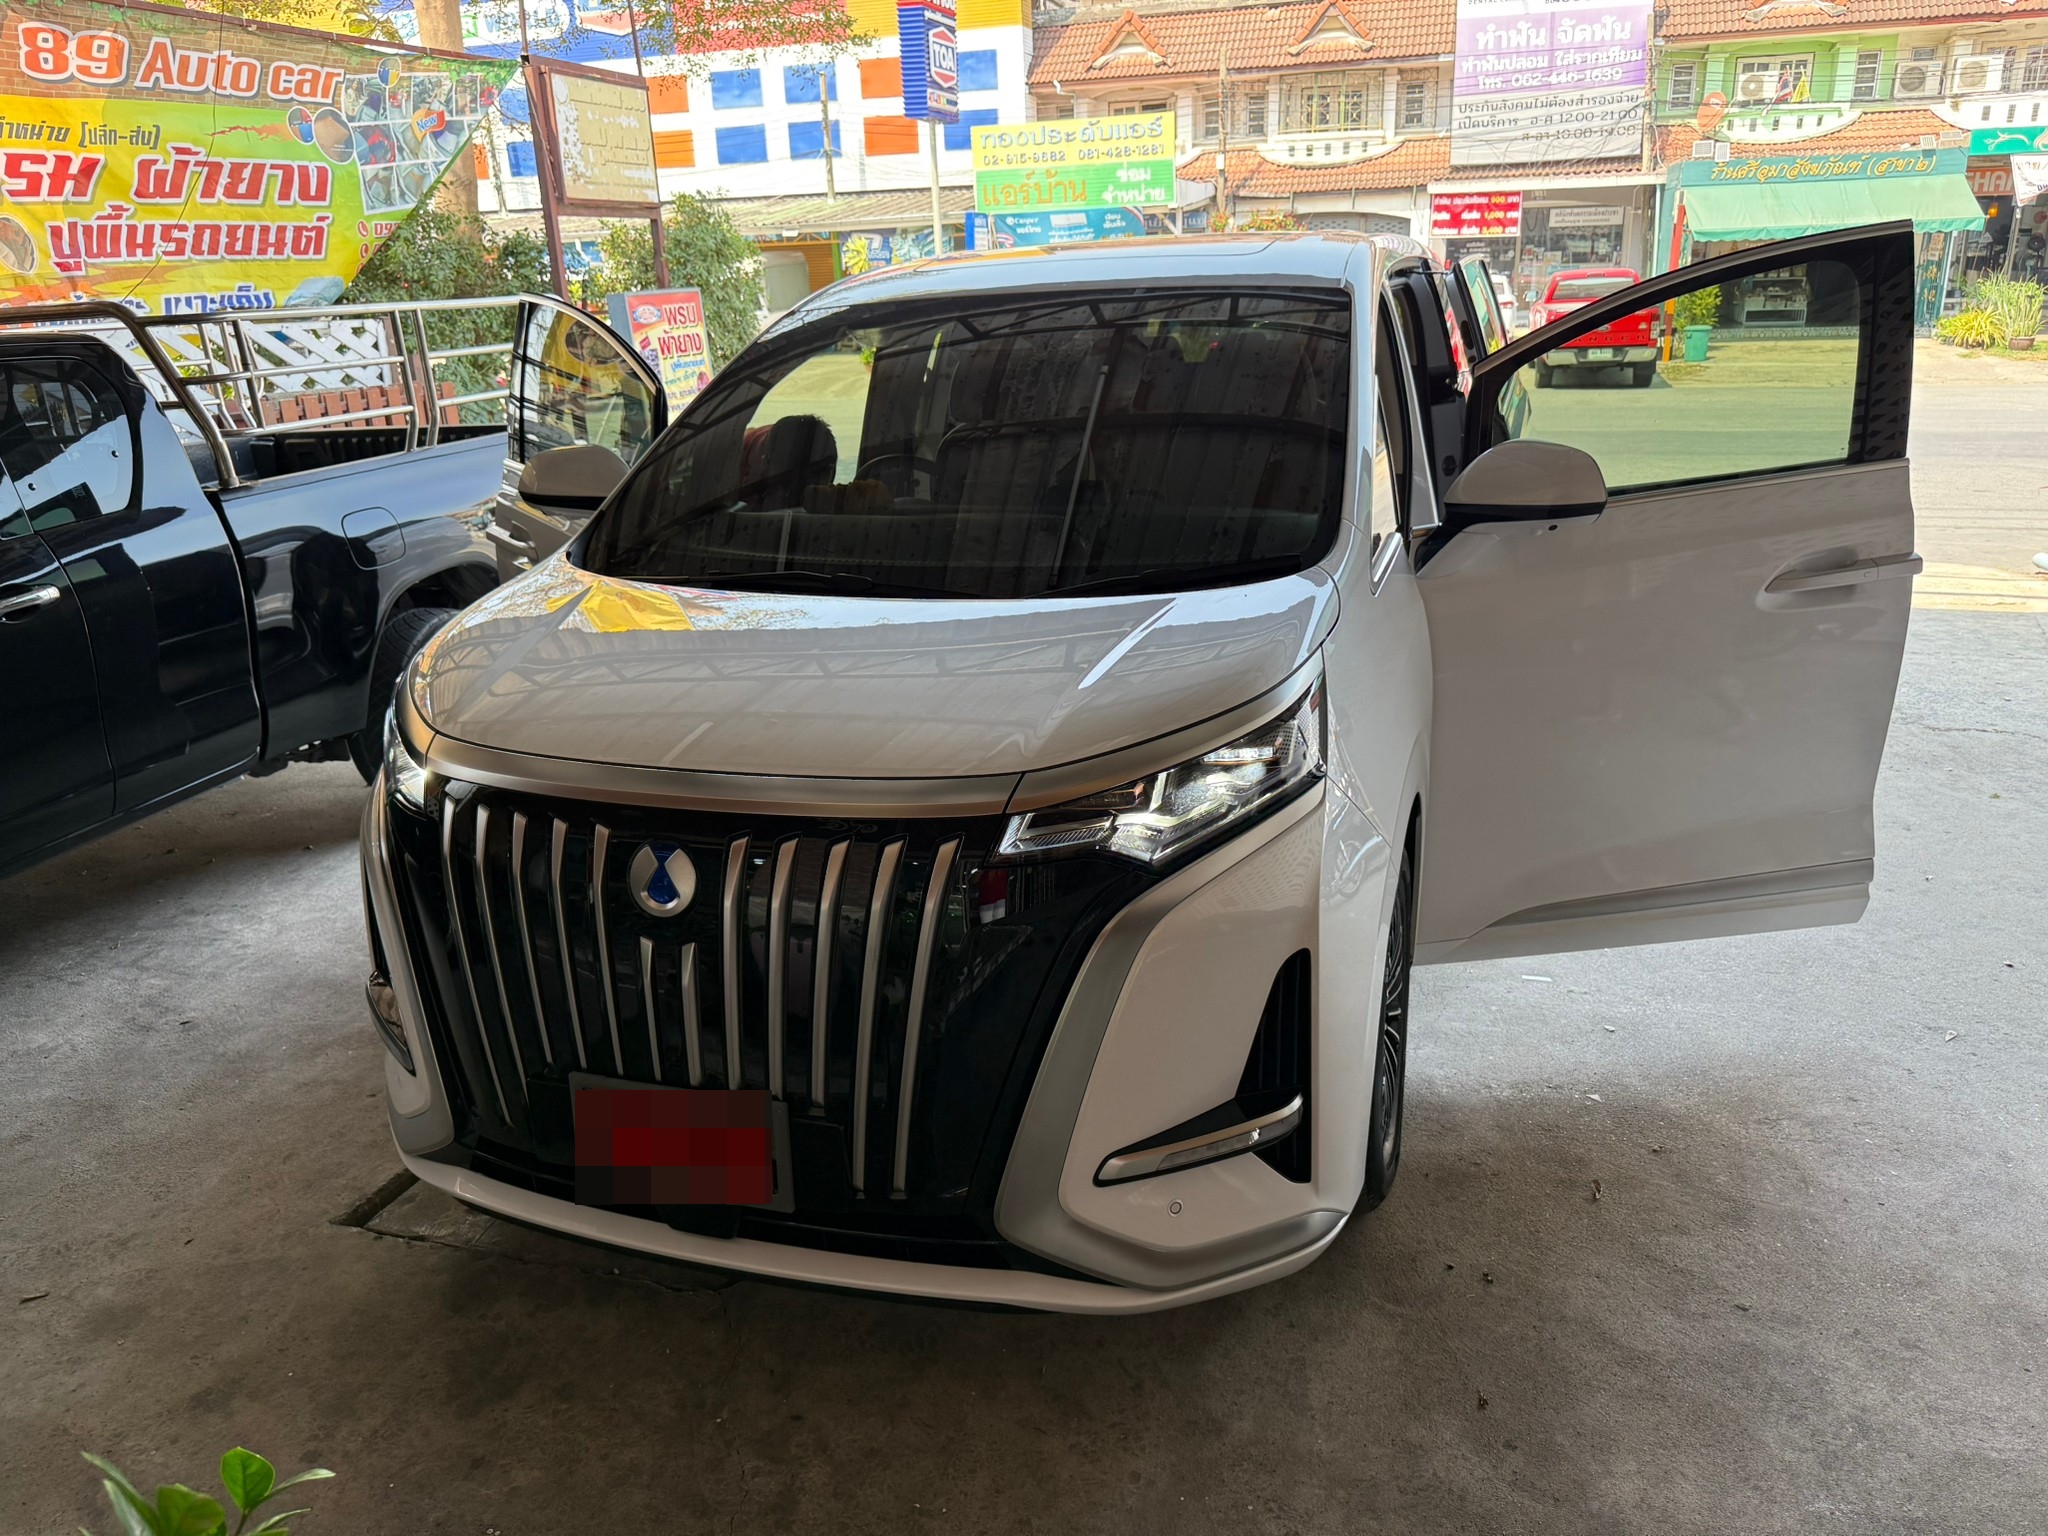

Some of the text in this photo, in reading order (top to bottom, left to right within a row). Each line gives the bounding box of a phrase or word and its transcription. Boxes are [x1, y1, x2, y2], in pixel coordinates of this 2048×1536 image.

[1475, 14, 1632, 50] ทำฟัน จัดฟัน
[19, 24, 342, 99] 89 Auto car
[933, 43, 955, 71] TOA
[1461, 54, 1549, 73] ทำฟันปลอม
[1458, 92, 1639, 114] ประกันสังคมไม่ต้องสำรองจ่าย
[0, 116, 70, 142] ำหน่าย
[416, 115, 438, 132] New
[980, 115, 1163, 149] ทองประดับแอร์
[1458, 115, 1519, 130] เปิดบริการ
[133, 145, 331, 205] ผ้ายาง
[982, 168, 1088, 206] แอร์บ้าน
[1101, 184, 1166, 205] จำหน่าย
[48, 205, 330, 274] ปูพื้นรถยนต์
[374, 222, 401, 237] 09
[664, 305, 697, 327] พรม
[657, 329, 702, 356] ผ้ายาง
